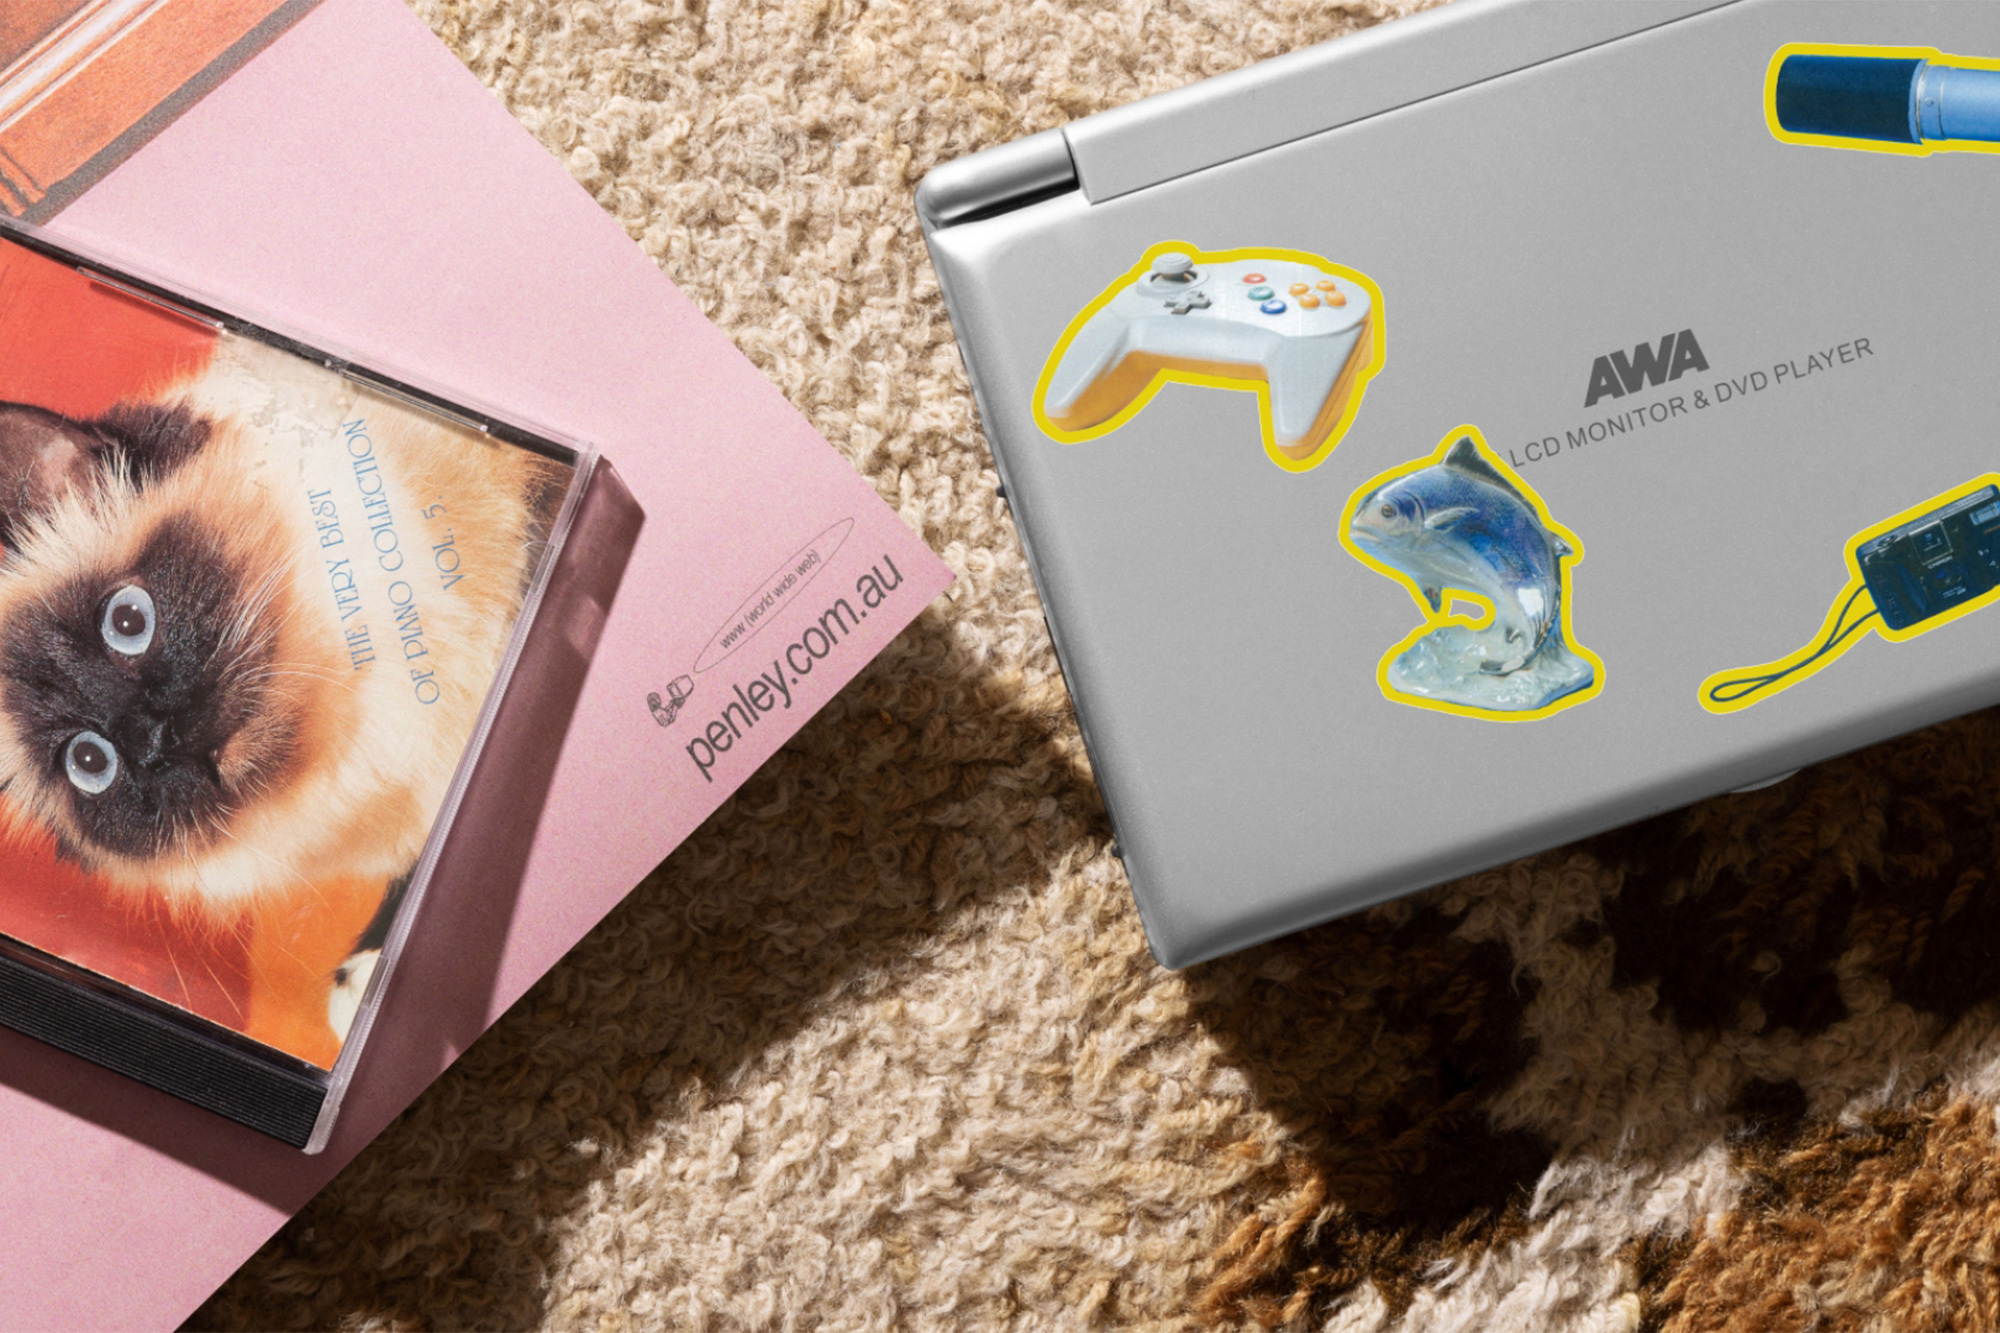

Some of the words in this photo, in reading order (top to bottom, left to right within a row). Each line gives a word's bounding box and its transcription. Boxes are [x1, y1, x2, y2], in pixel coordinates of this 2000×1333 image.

[1509, 436, 1560, 468] LCD
[1566, 396, 1688, 449] MONITOR
[1694, 389, 1710, 409] &
[1714, 371, 1768, 402] DVD
[1773, 337, 1874, 384] PLAYER
[1584, 328, 1710, 408] AWA
[307, 488, 344, 549] BEST
[342, 418, 404, 572] COLLECTION
[326, 558, 363, 622] VERY
[432, 527, 465, 590] VOL.
[388, 581, 429, 660] PIANO
[720, 622, 746, 648] www
[743, 592, 775, 627] (world
[772, 573, 797, 597] wide
[795, 549, 821, 576] web)
[344, 625, 376, 670] THE
[410, 669, 440, 704] OF
[685, 554, 904, 783] penley.com.au
